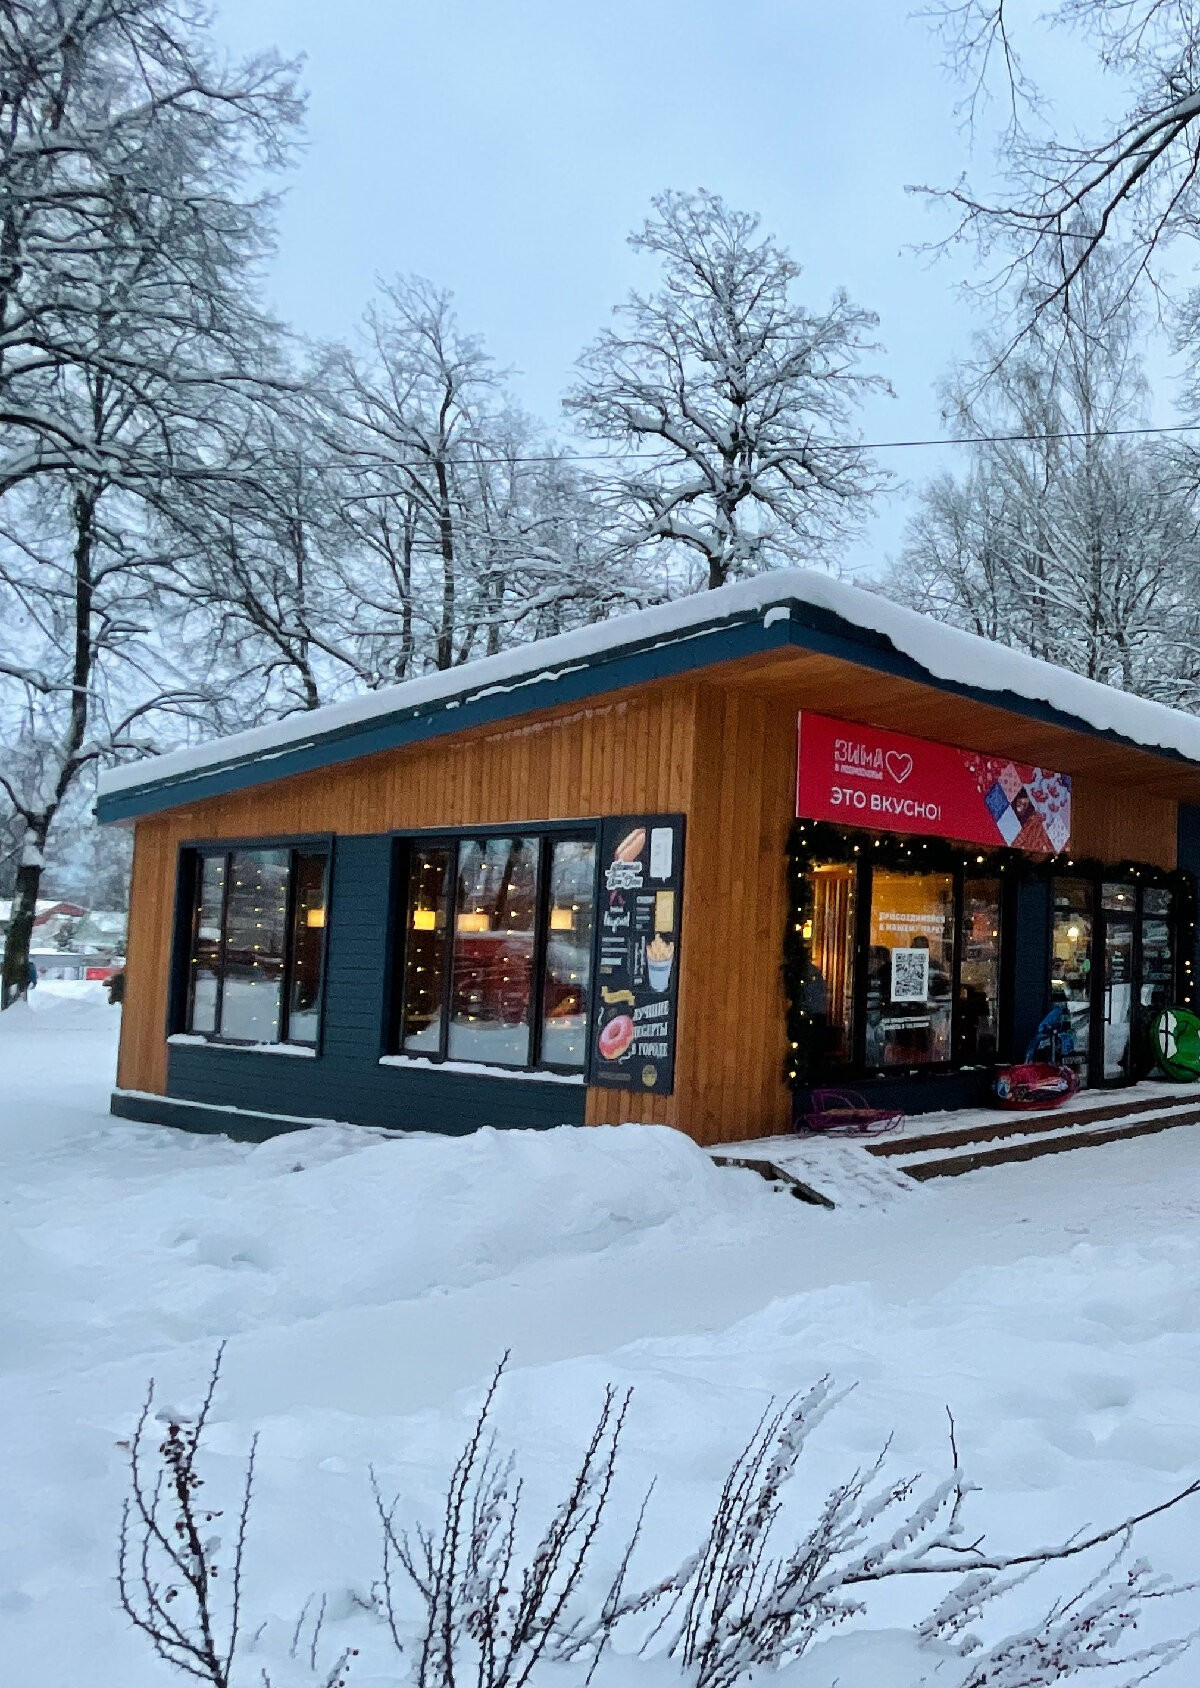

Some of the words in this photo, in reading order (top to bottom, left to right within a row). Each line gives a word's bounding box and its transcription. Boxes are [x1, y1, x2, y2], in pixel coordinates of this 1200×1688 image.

[834, 738, 884, 769] ЗИМА
[830, 786, 867, 809] ЭТО
[870, 794, 942, 820] ВКУСНО!
